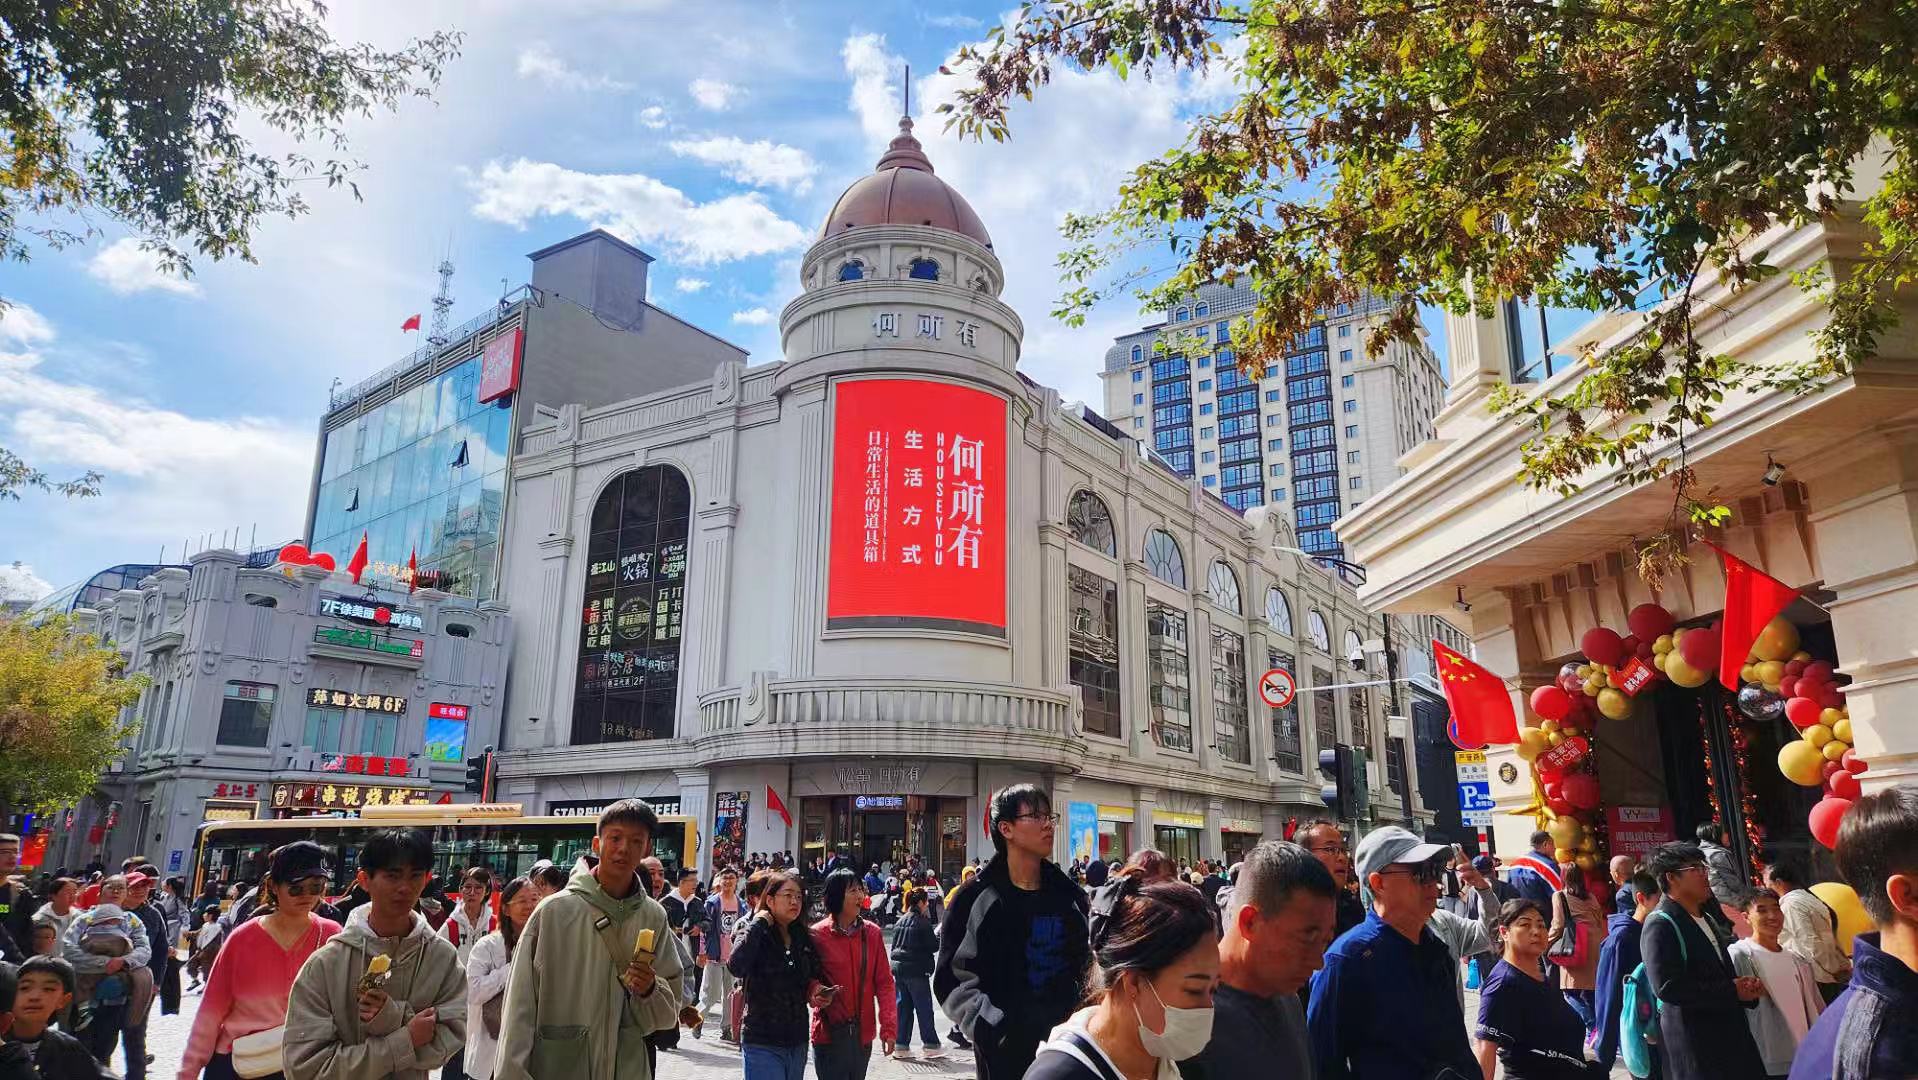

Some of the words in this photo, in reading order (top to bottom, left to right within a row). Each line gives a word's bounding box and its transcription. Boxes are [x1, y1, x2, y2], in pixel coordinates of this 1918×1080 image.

[872, 312, 981, 348] 何所有
[863, 430, 882, 563] 日常生活的道具箱
[901, 430, 924, 565] 生活方式
[934, 431, 945, 566] HOUSEVOU
[947, 433, 985, 569] 何所有
[1461, 785, 1478, 808] P
